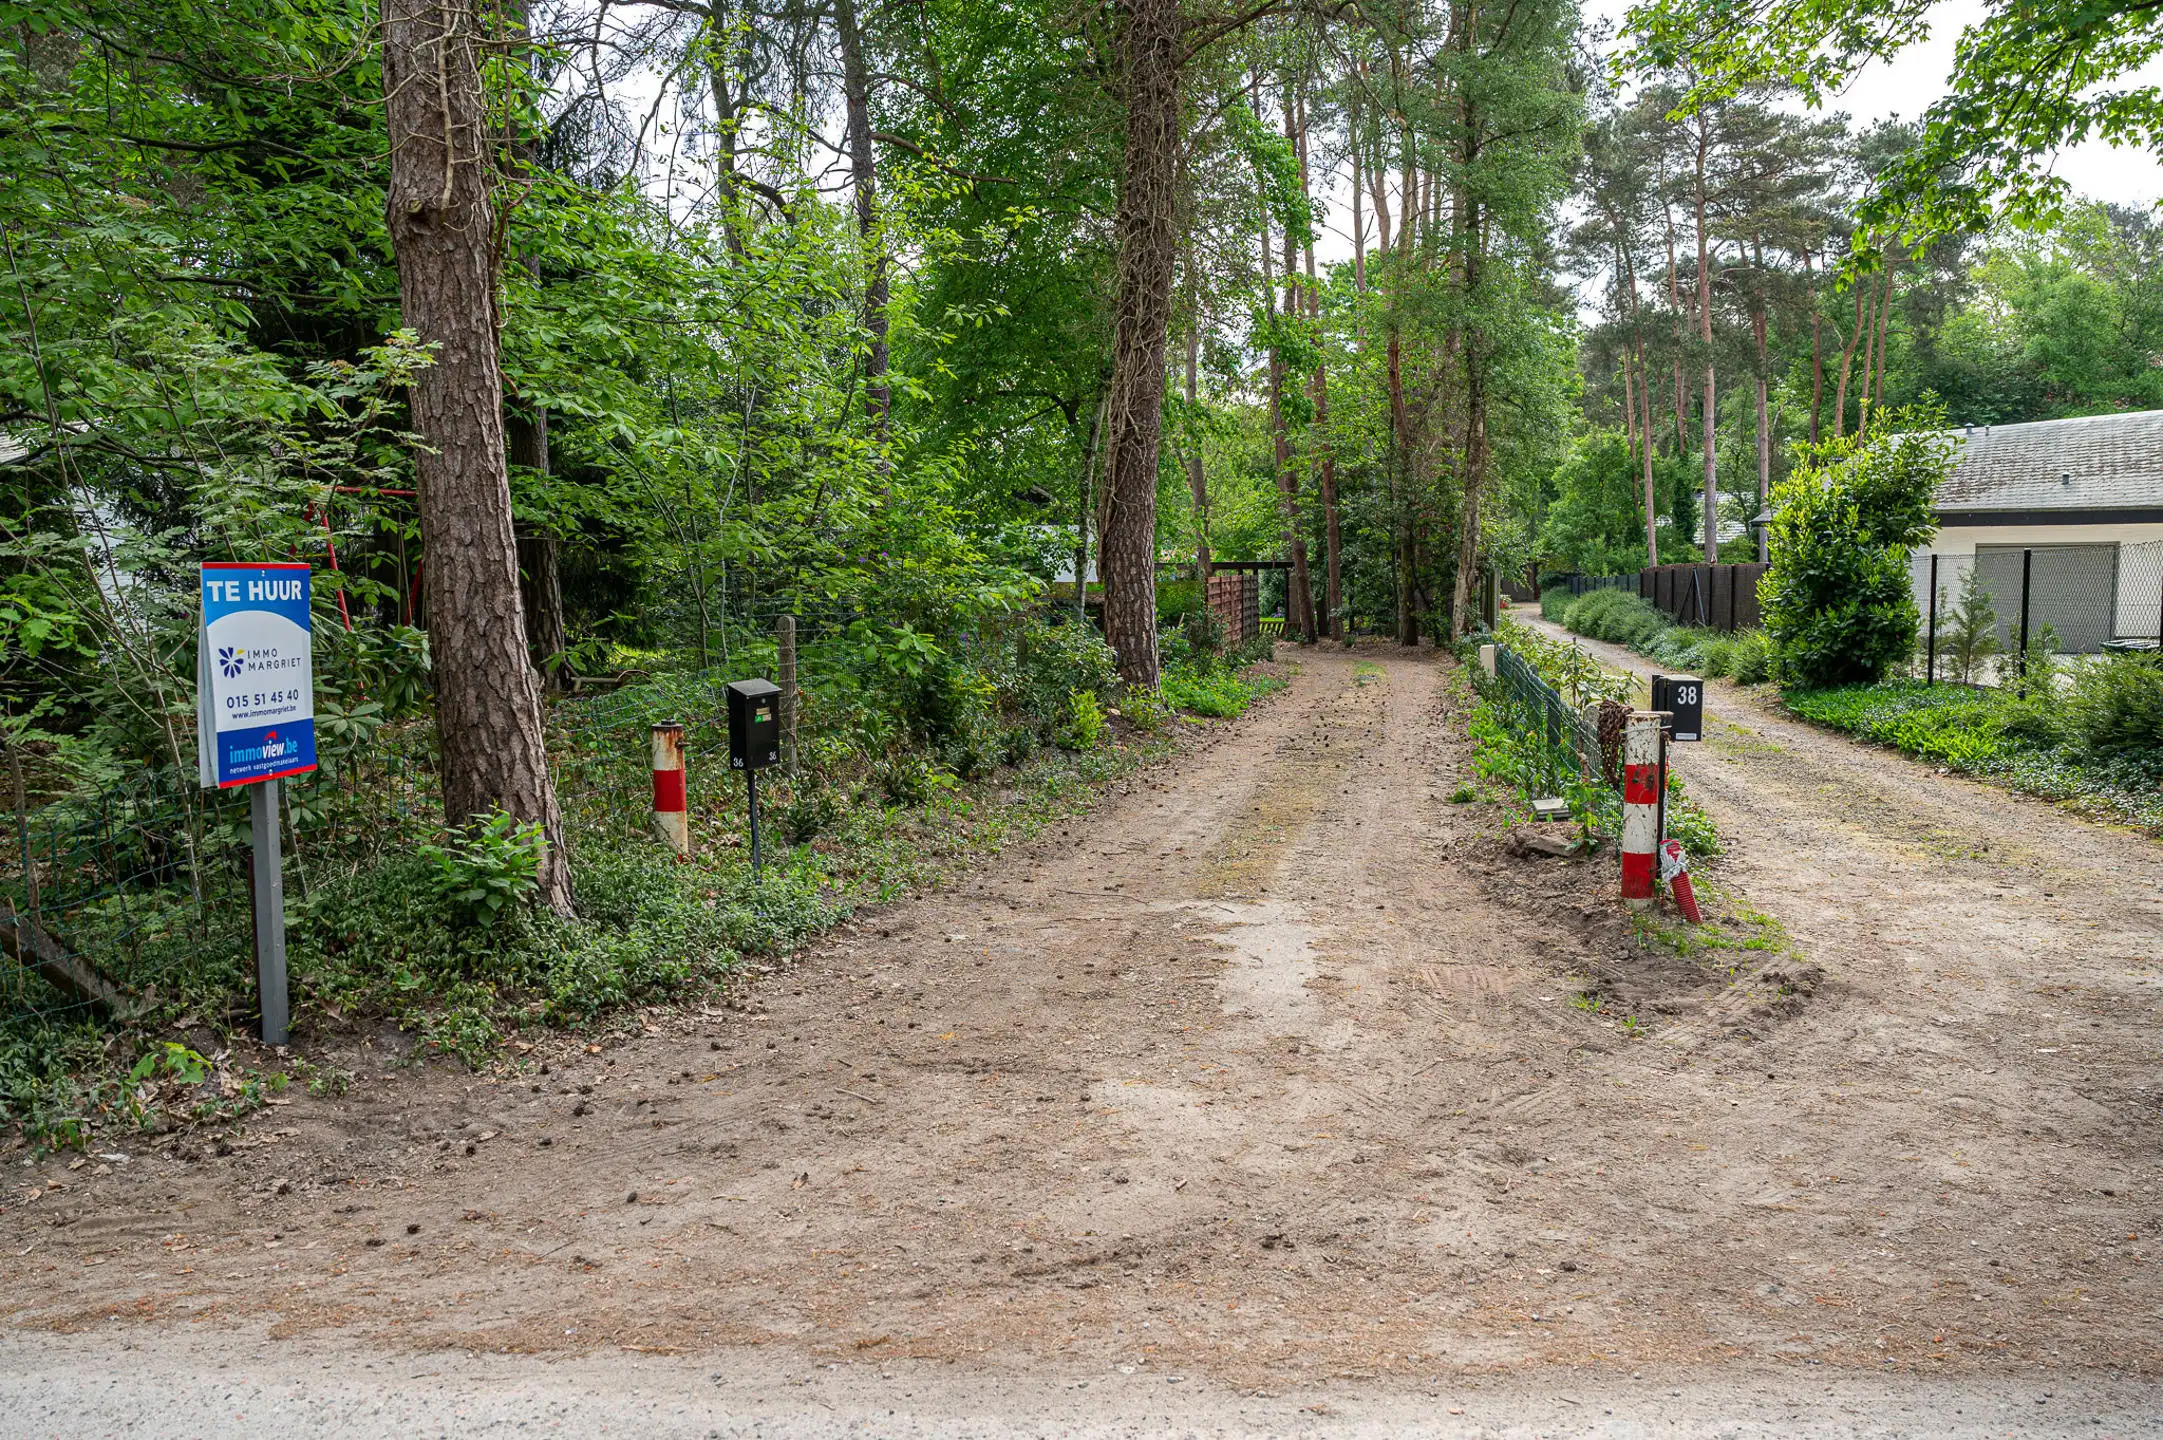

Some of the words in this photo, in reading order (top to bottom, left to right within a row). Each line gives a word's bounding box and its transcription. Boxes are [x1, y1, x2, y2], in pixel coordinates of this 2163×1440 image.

[206, 580, 241, 602] TE
[247, 580, 302, 601] HUUR
[247, 648, 278, 659] IMMO
[248, 657, 301, 671] MARGRIET
[226, 695, 249, 709] 015
[254, 693, 266, 706] 51
[270, 691, 283, 704] 45
[287, 688, 299, 701] 40
[1677, 685, 1697, 705] 38
[231, 705, 297, 720] www.immomargriet.be
[229, 736, 298, 765] immoview.be
[733, 756, 744, 767] 36
[229, 764, 252, 775] netwerk
